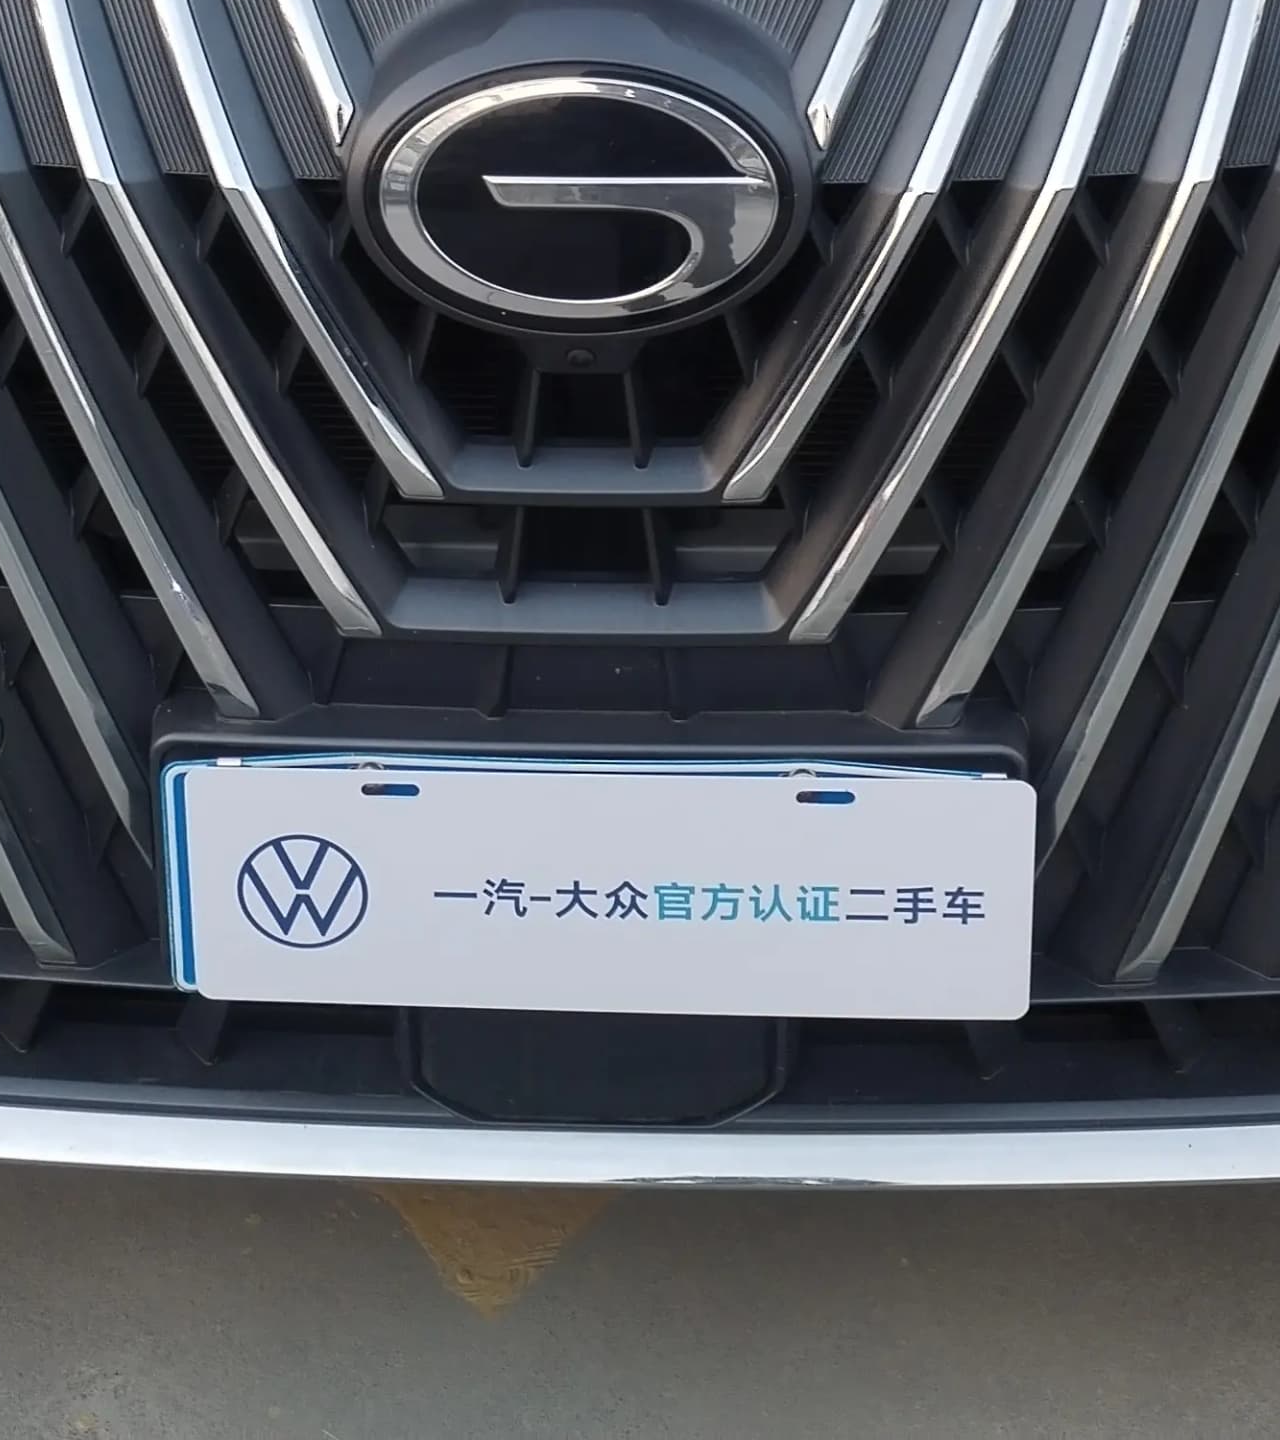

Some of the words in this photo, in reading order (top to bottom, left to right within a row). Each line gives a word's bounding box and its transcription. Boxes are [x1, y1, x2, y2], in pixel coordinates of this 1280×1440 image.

[433, 878, 986, 925] 一汽-大众官方认证二手车
